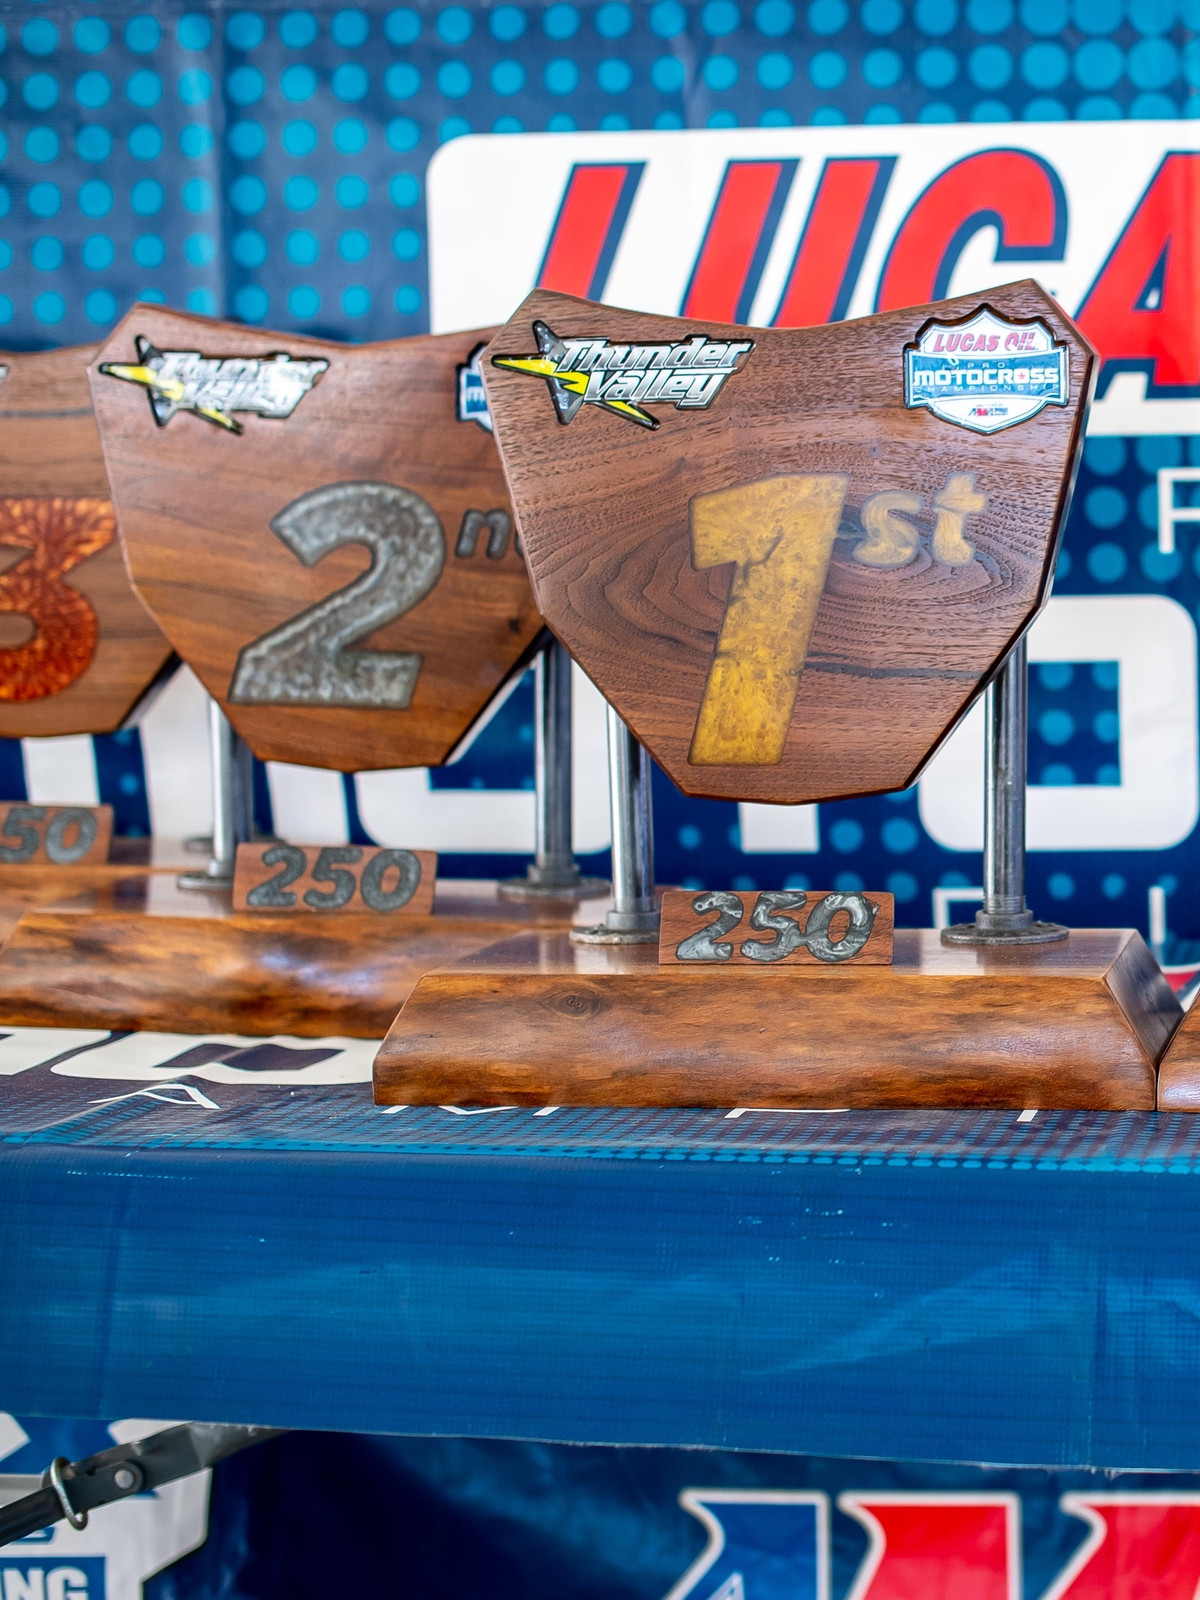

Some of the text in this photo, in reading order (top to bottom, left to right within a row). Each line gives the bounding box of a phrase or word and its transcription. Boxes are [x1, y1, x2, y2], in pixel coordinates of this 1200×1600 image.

[555, 336, 753, 374] Thunder
[933, 332, 1036, 352] LUCAS OIL
[583, 367, 738, 407] Valley
[913, 368, 1059, 386] MOTOCROSS
[913, 384, 1060, 393] CHAMPIONSHIP
[227, 480, 524, 709] 2n
[688, 471, 989, 766] 1st
[0, 806, 98, 864] 50
[245, 847, 422, 911] 250
[675, 890, 878, 962] 250
